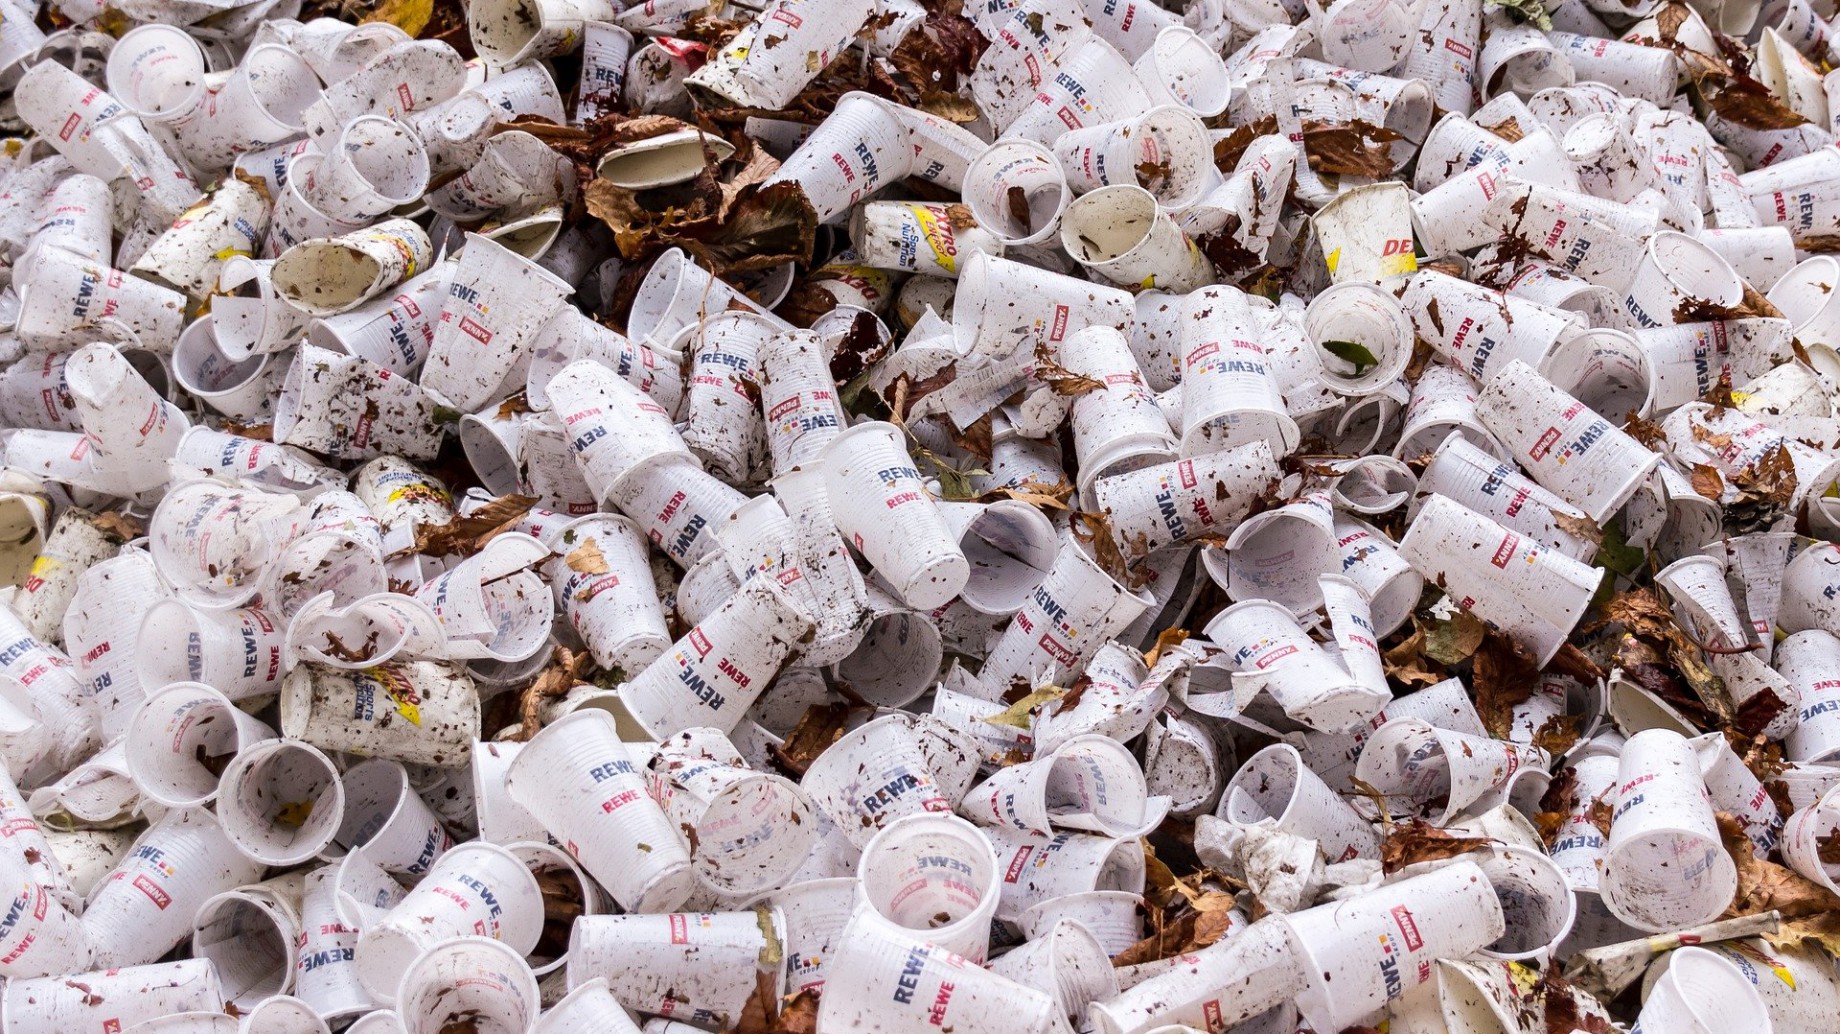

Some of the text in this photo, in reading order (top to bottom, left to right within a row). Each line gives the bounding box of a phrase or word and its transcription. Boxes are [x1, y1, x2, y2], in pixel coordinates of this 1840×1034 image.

[772, 9, 802, 28] PENNY
[1104, 0, 1116, 16] RE
[1122, 5, 1134, 32] REWE
[1001, 29, 1020, 48] EWE
[1445, 38, 1470, 59] PENNY
[1572, 33, 1586, 47] RE
[1593, 38, 1611, 57] REW
[595, 69, 622, 85] REW
[1024, 53, 1040, 85] PENN
[1055, 72, 1085, 100] REWE
[1057, 106, 1083, 128] PENN
[1291, 133, 1304, 142] RE
[832, 152, 855, 183] REWE
[855, 143, 878, 183] REWE
[1084, 148, 1092, 180] REWE
[1466, 143, 1486, 171] WE
[1657, 156, 1688, 166] REWE
[1760, 142, 1783, 167] REWE
[274, 157, 287, 189] EWE
[1096, 154, 1110, 187] REW
[1775, 191, 1788, 221] REWE
[1798, 193, 1811, 230] REWE
[924, 221, 945, 258] ENERGY
[926, 206, 957, 255] EXTRO
[1546, 219, 1566, 247] REWE
[1382, 239, 1411, 257] DE
[1565, 239, 1591, 272] REWE
[74, 275, 92, 318] REWE
[104, 297, 117, 317] WE
[450, 283, 475, 303] EWE
[459, 316, 493, 345] PENNY
[1050, 304, 1069, 341] PENNY
[1452, 317, 1472, 349] REWE
[394, 321, 414, 364] REWE
[1186, 342, 1219, 367] PENNY
[1232, 340, 1262, 354] REWE
[617, 350, 630, 377] WE
[701, 353, 748, 370] REWE
[1218, 361, 1266, 375] REWE
[1472, 337, 1497, 379] REWE
[1694, 347, 1708, 396] REWE
[770, 396, 800, 420] PENNY
[812, 391, 831, 400] WE
[565, 408, 601, 425] REWE
[800, 414, 836, 430] EWE
[574, 426, 607, 453] REW
[1529, 426, 1562, 461] PENNY
[1573, 421, 1608, 456] REWE
[222, 440, 243, 466] REW
[246, 444, 262, 469] REW
[570, 503, 597, 513] NNY
[659, 490, 687, 524] REWE
[887, 492, 919, 509] REWE
[1193, 498, 1212, 526] EWE
[1504, 486, 1531, 518] REWE
[1155, 490, 1185, 541] REWE
[531, 525, 541, 538] WE
[679, 514, 707, 557] REWE
[562, 573, 579, 608] EWE
[592, 575, 619, 595] NNY
[1035, 590, 1067, 624] REWE
[1462, 596, 1475, 608] RE
[0, 637, 38, 666] REWE
[87, 641, 111, 661] REW
[243, 627, 257, 678] REWE
[267, 645, 279, 682] REWE
[1256, 645, 1298, 669] PENNY
[20, 666, 47, 686] EWE
[717, 657, 750, 688] REWE
[1813, 680, 1840, 690] EWE
[680, 666, 725, 709] REWE
[1543, 684, 1560, 695] PEN
[364, 685, 374, 721] Sports
[1801, 699, 1838, 721] EWE
[601, 789, 640, 813] REWE
[865, 774, 916, 810] REWE
[1006, 793, 1029, 830] REW
[408, 830, 436, 874] REWE
[1046, 834, 1069, 853] WE
[1004, 844, 1032, 884] PENNY
[133, 875, 172, 908] PENNY
[433, 886, 470, 910] REWE
[459, 876, 501, 917] REWE
[0, 898, 25, 940] EWE
[1391, 904, 1422, 951] PENNY
[3, 934, 35, 963] REWE
[304, 948, 355, 970] REWE
[786, 953, 800, 973] WE
[893, 947, 927, 1004] REWE
[930, 982, 955, 1026] REWE
